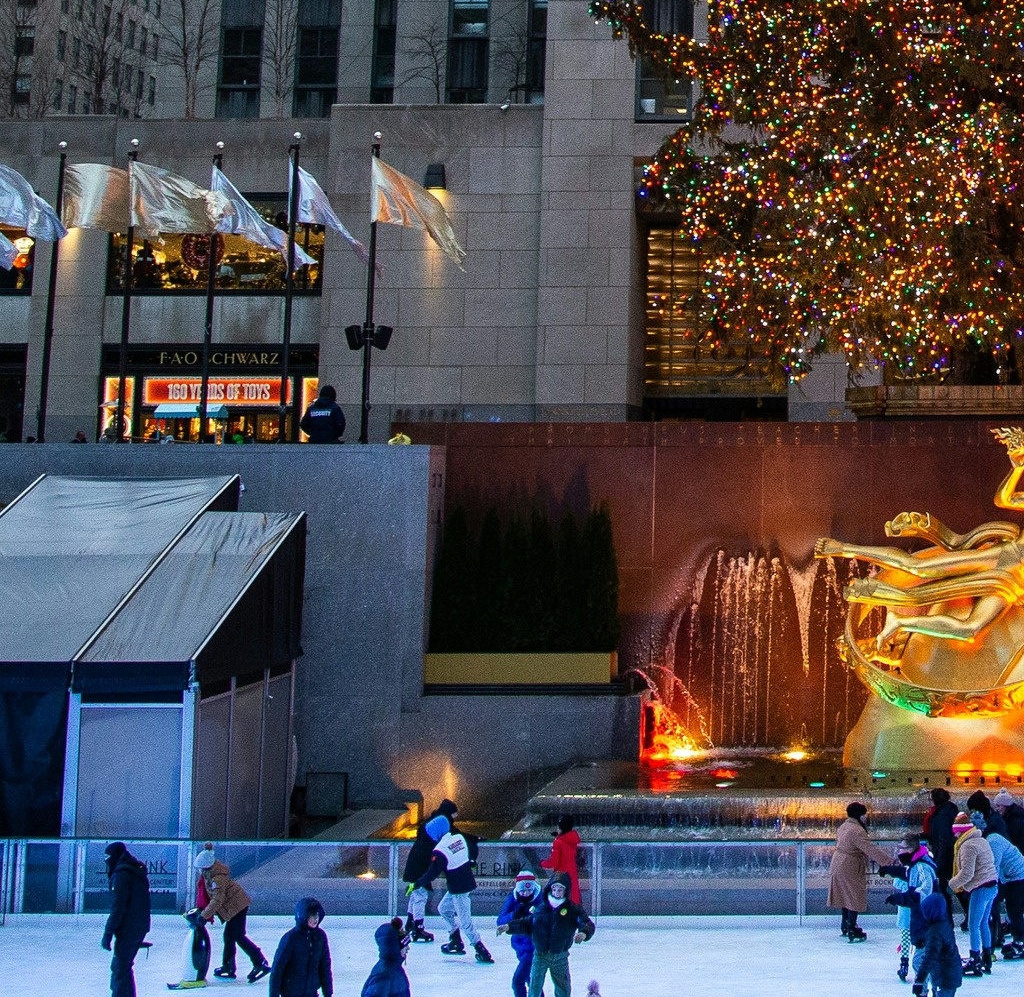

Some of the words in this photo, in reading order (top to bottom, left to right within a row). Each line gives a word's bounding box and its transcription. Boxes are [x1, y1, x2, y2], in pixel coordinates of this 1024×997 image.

[207, 352, 279, 365] CHWARZ
[167, 383, 188, 401] 160
[226, 383, 241, 401] OF
[242, 383, 271, 401] TOYS
